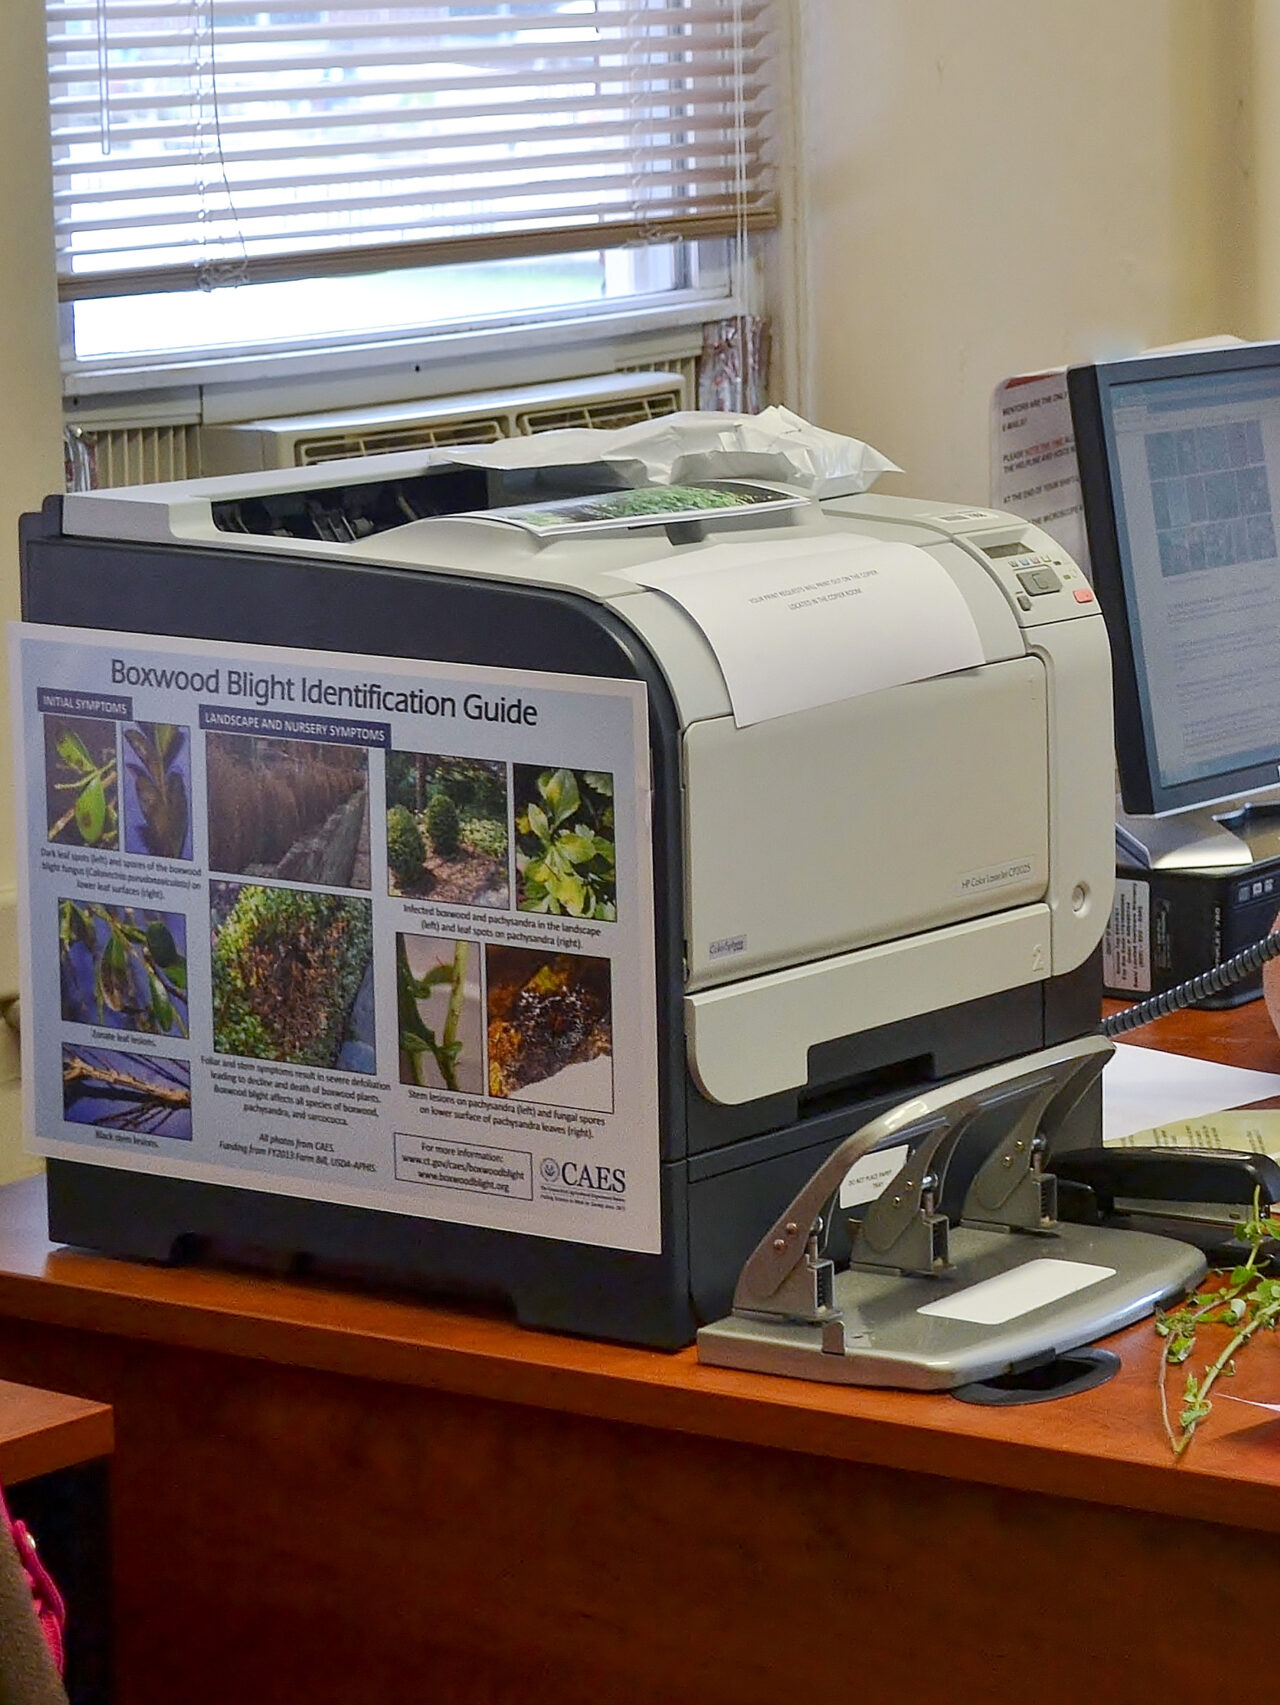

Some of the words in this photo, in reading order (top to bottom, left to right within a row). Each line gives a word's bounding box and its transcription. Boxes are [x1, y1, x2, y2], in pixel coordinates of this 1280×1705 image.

[43, 696, 72, 709] INITIAL
[75, 699, 127, 715] SYMPTOMS
[112, 660, 219, 694] Boxwood
[227, 670, 294, 706] Blight
[302, 678, 456, 718] Identification
[463, 694, 538, 726] Guide
[205, 713, 260, 729] LANDSCAPE
[262, 719, 282, 731] AND
[284, 721, 327, 736] NURSERY
[329, 726, 385, 742] SYMPTOMS
[962, 879, 970, 888] HP
[971, 877, 986, 888] Color
[403, 904, 434, 915] Infected
[436, 908, 470, 919] boxwood
[488, 916, 536, 927] pachysandra
[547, 922, 560, 930] the
[562, 924, 601, 937] landscape
[421, 922, 440, 933] (left)
[458, 926, 471, 934] leaf
[473, 929, 494, 938] spots
[507, 934, 555, 944] pachysandra
[557, 938, 583, 950] (right).
[201, 1057, 220, 1066] Foliar
[238, 1063, 255, 1071] stem
[257, 1067, 293, 1076] symptoms
[327, 1076, 349, 1084] severe
[351, 1078, 391, 1090] defoliation
[211, 1072, 236, 1084] leading
[248, 1077, 272, 1087] decline
[290, 1083, 310, 1092] death
[322, 1088, 355, 1098] boxwood
[357, 1093, 381, 1102] plants.
[214, 1086, 247, 1097] Boxwood
[249, 1091, 268, 1101] blight
[270, 1094, 294, 1103] affects
[306, 1100, 331, 1108] species
[343, 1104, 379, 1117] boxwood,
[243, 1106, 290, 1119] pachysandra,
[408, 1091, 427, 1100] Stem
[429, 1093, 454, 1104] lesions
[468, 1101, 515, 1112] pachysandra
[517, 1106, 536, 1117] (left)
[553, 1111, 578, 1122] fungal
[579, 1116, 605, 1125] spores
[432, 1108, 452, 1118] lower
[454, 1113, 481, 1122] surface
[493, 1118, 540, 1130] pachysandra
[542, 1123, 566, 1134] leaves
[567, 1127, 594, 1139] (right).
[219, 1141, 247, 1154] Funding
[249, 1145, 267, 1154] from
[270, 1136, 294, 1145] photos
[295, 1139, 313, 1148] from
[421, 1143, 434, 1152] For
[457, 1148, 503, 1162] information:
[402, 1156, 525, 1180] www.ct.gov/caes/boxwoodblight
[418, 1171, 510, 1193] www.boxwoodblight.org
[562, 1162, 626, 1194] CAES
